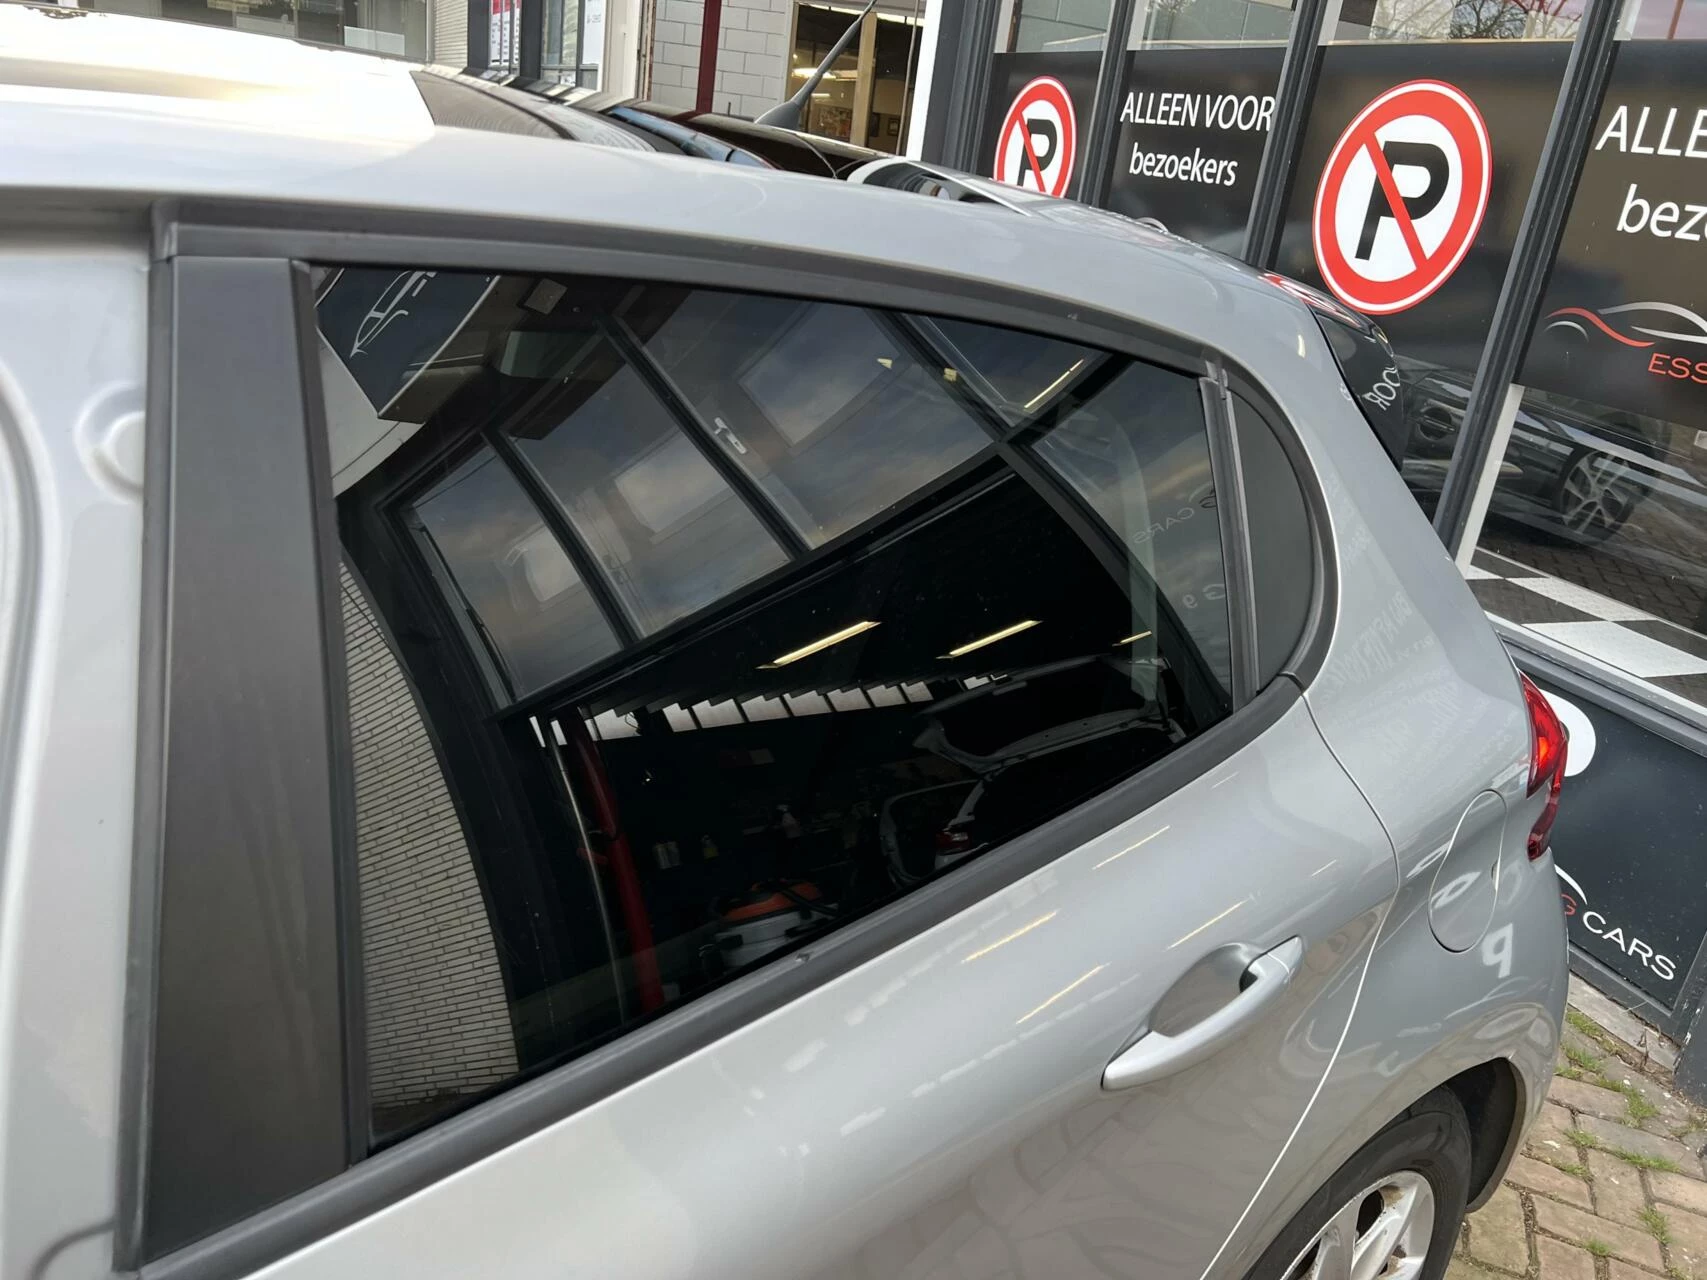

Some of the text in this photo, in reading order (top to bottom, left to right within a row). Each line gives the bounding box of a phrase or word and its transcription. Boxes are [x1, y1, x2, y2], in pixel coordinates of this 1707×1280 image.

[1120, 91, 1276, 132] ALLEEN VOOR
[1129, 141, 1238, 187] bezoekers
[1354, 140, 1450, 262] P
[1616, 183, 1707, 242] bez
[1647, 352, 1707, 384] ESS
[1582, 910, 1677, 981] CARS
